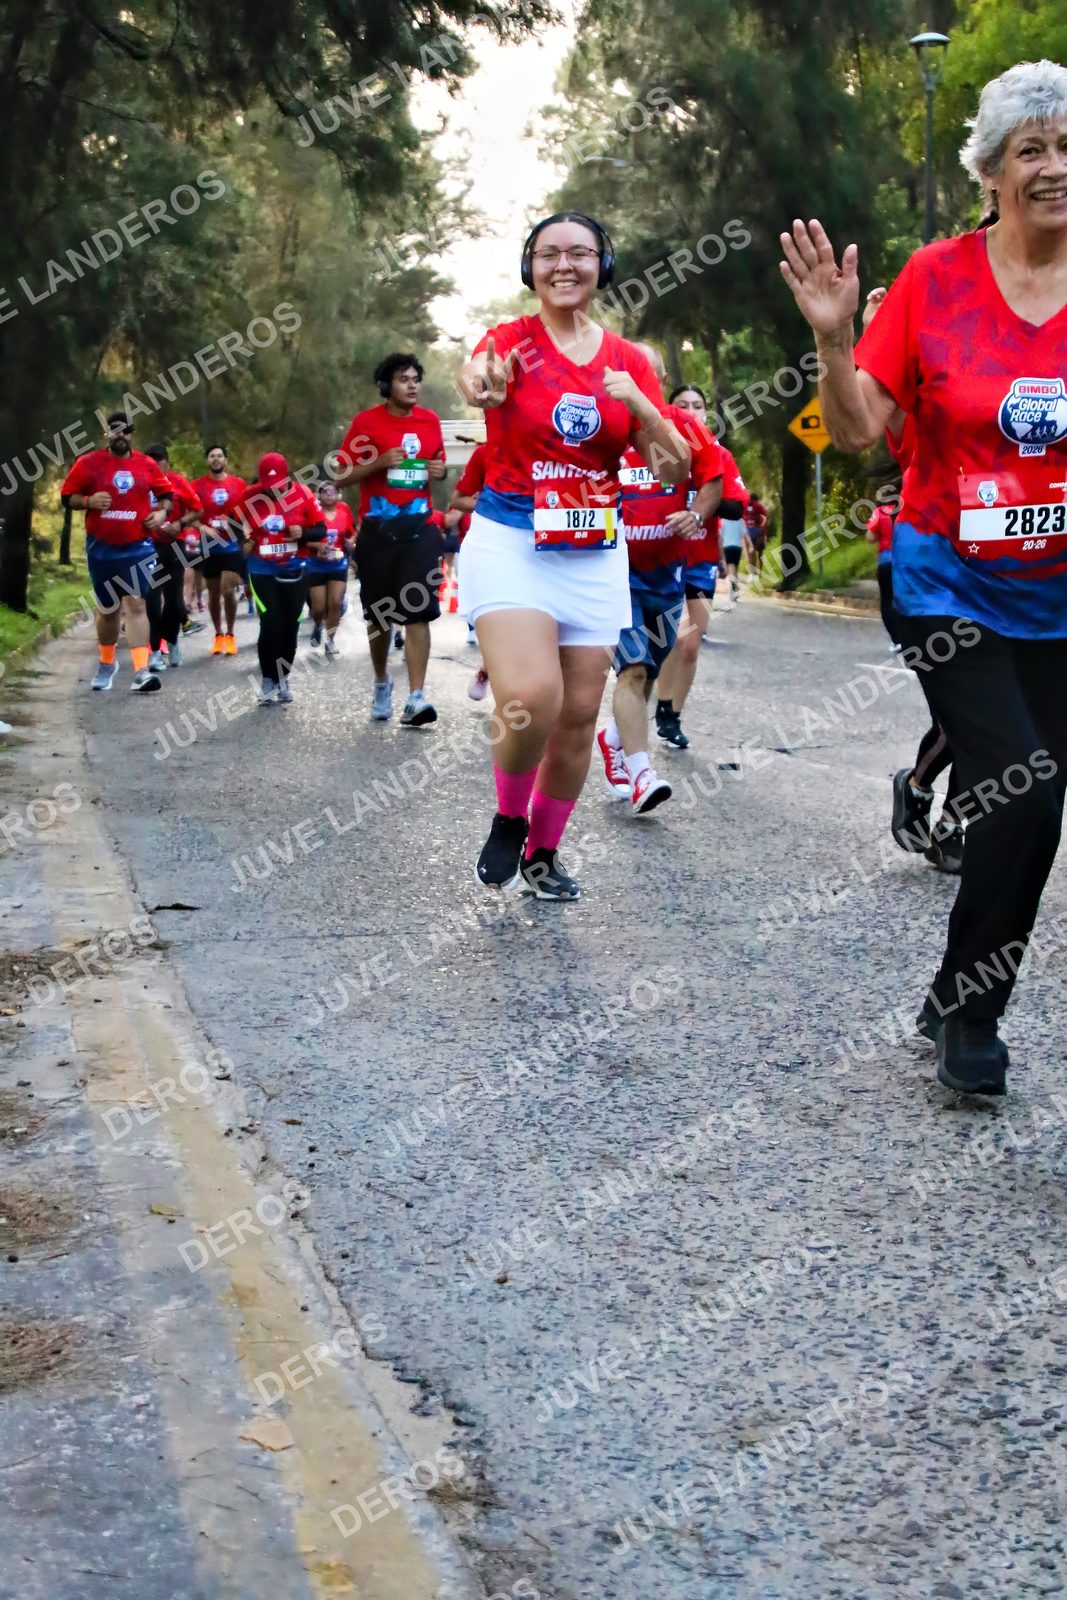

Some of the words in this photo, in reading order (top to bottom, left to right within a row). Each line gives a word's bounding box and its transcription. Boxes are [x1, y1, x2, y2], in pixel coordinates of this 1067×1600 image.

[1018, 385, 1058, 394] BIMBO
[565, 405, 591, 417] Global
[1019, 398, 1058, 412] Global
[1010, 409, 1042, 422] Race
[1021, 445, 1043, 455] 2026
[404, 470, 416, 480] 747
[630, 468, 655, 483] 347
[566, 510, 595, 528] 1872
[1005, 505, 1066, 537] 2823
[624, 524, 673, 540] ANTIAG
[1022, 539, 1047, 550] 20-26
